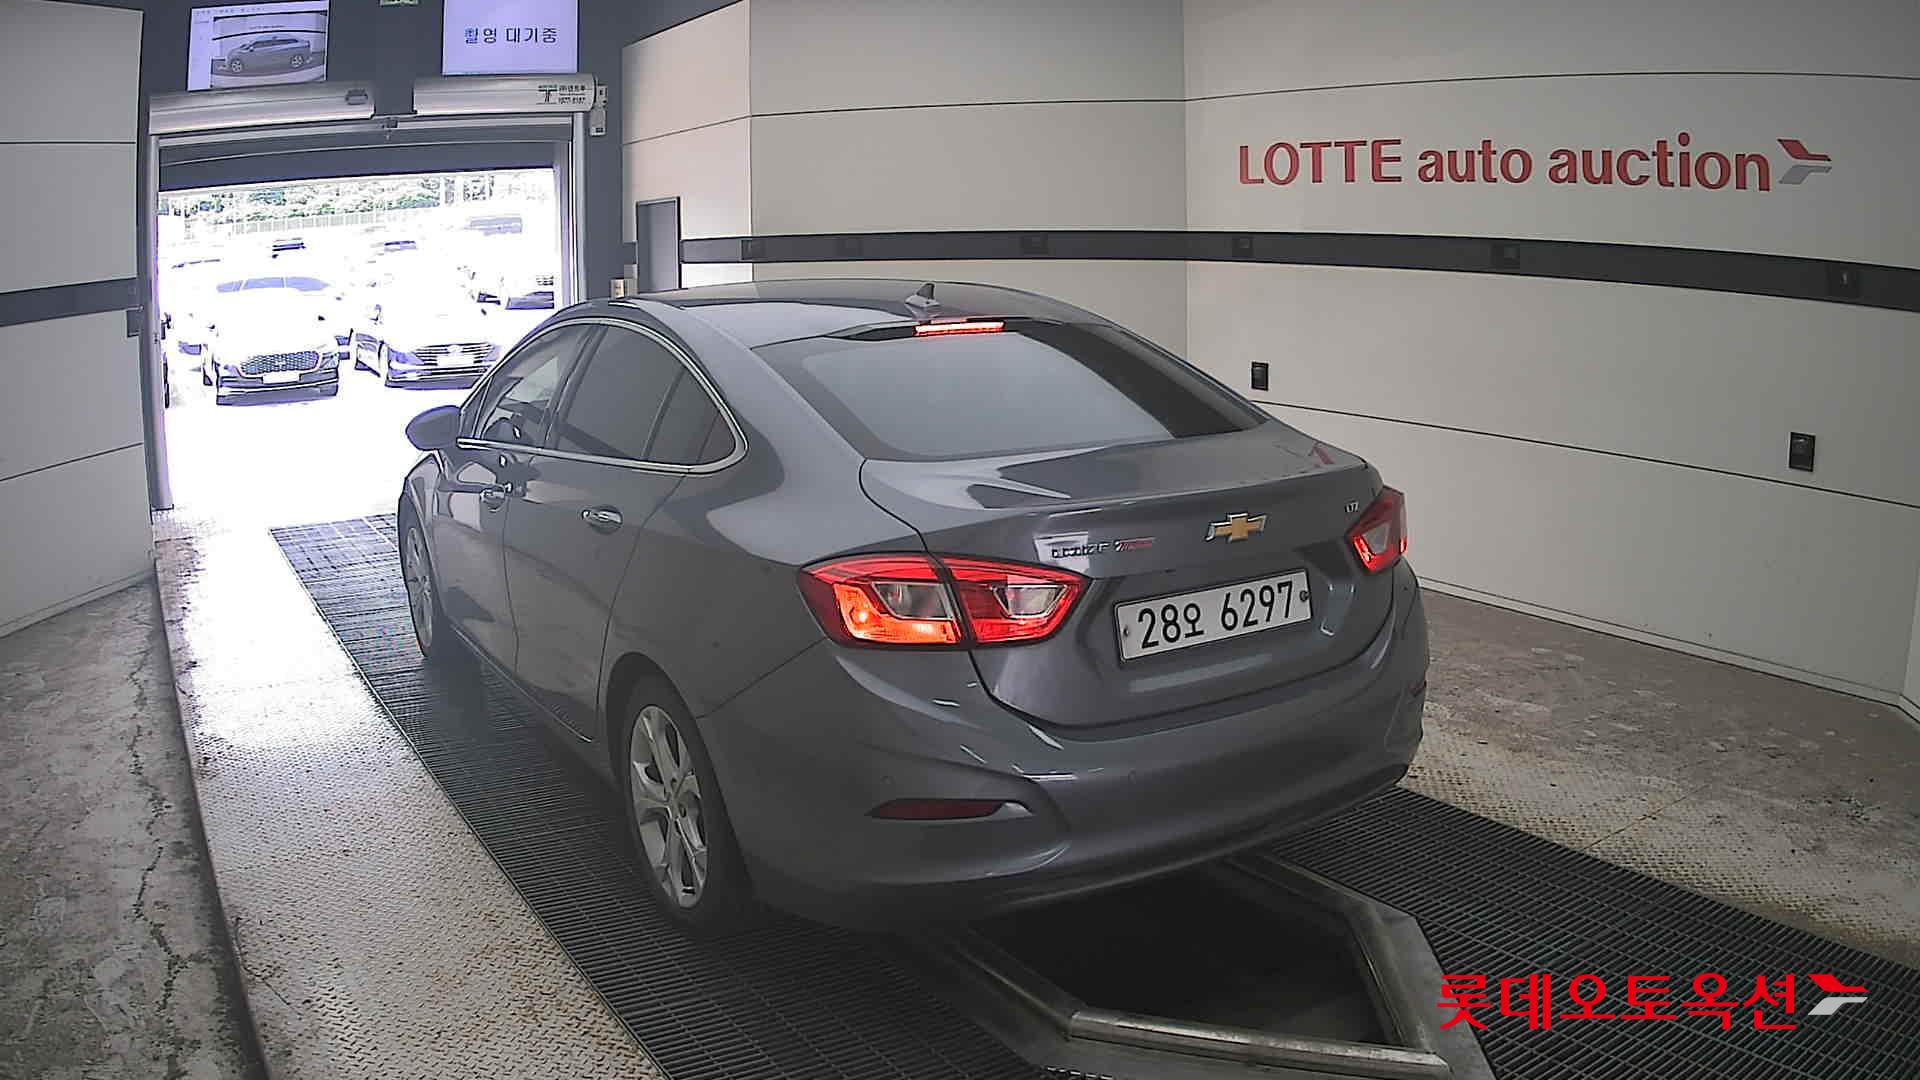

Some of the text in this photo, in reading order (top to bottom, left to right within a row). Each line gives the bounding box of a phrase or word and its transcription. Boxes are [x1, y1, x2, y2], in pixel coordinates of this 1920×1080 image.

[505, 27, 557, 43] 대기중
[1239, 132, 1771, 192] LOTTE auto auction
[1137, 580, 1294, 650] 28오 6297
